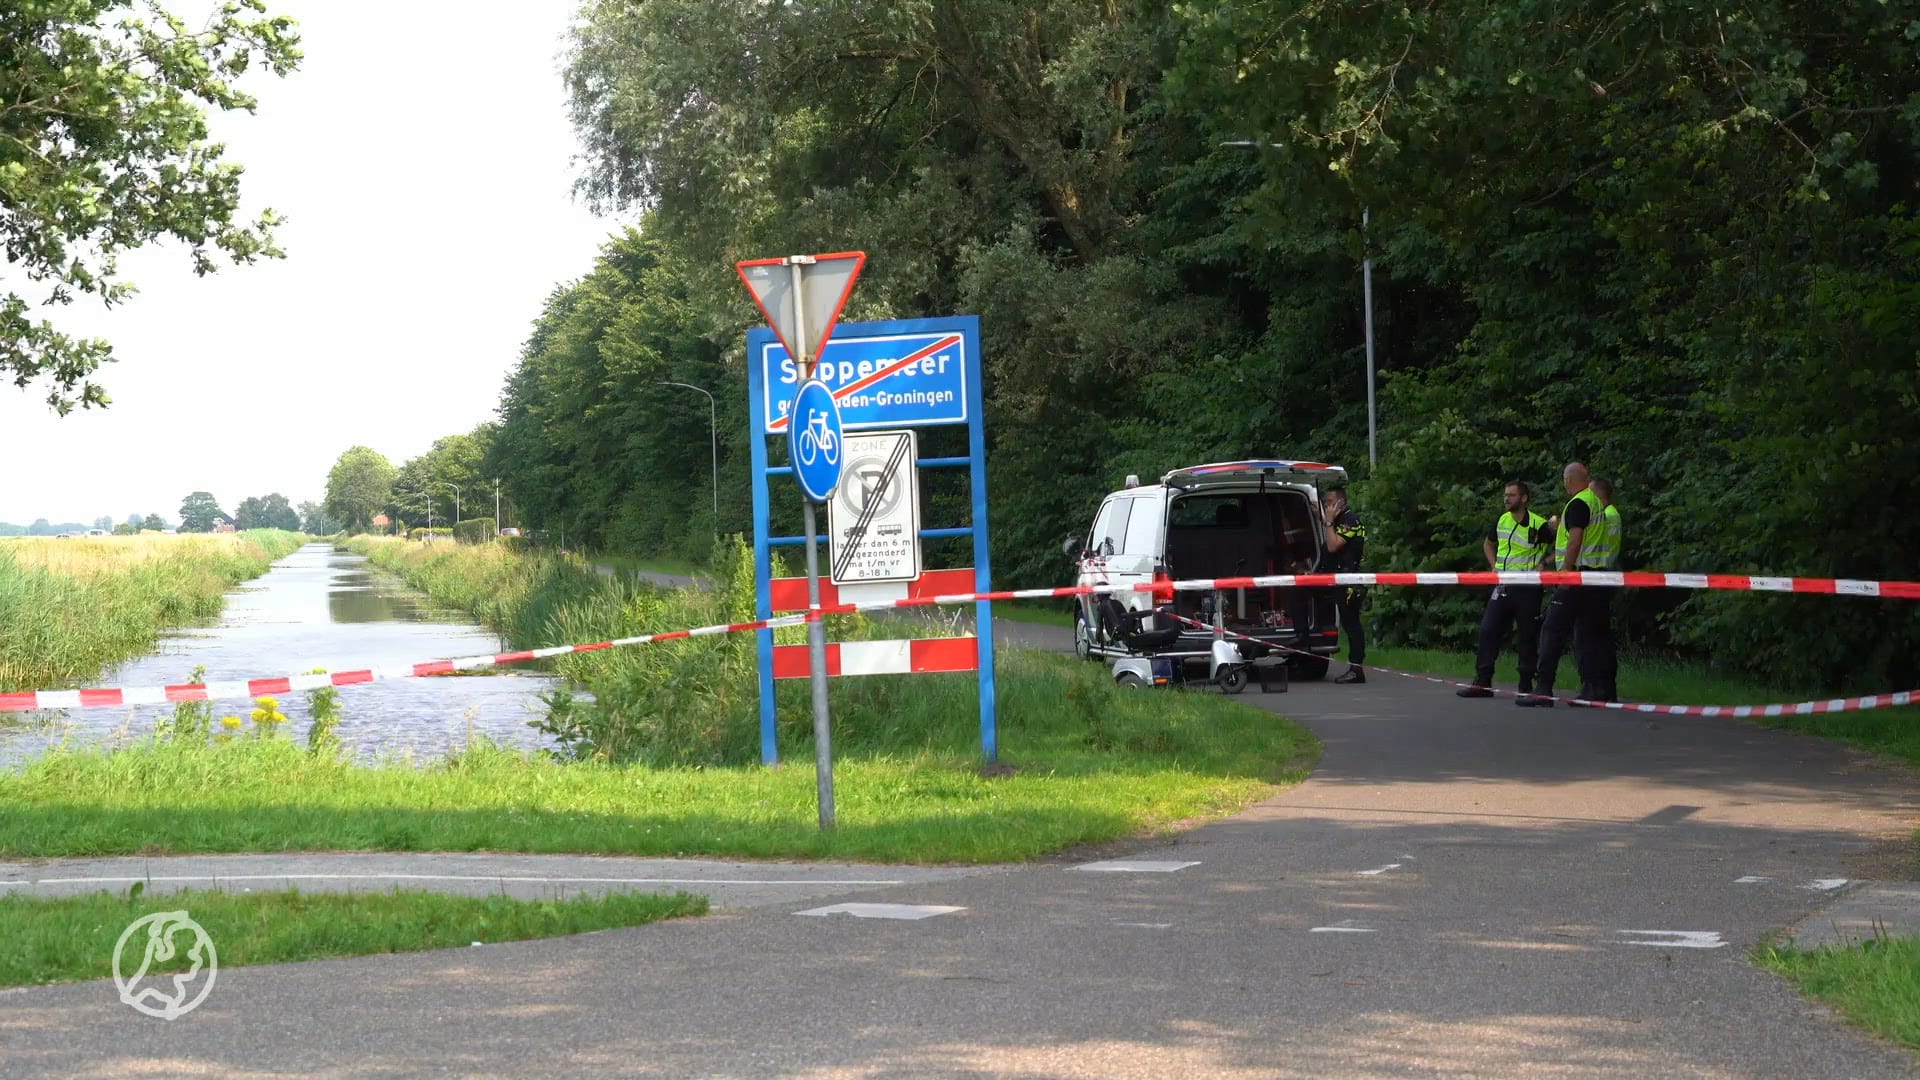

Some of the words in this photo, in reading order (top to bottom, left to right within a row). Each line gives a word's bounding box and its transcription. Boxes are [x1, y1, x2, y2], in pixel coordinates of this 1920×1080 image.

[780, 354, 950, 385] Sppemeer
[851, 440, 887, 452] ZONE
[867, 559, 886, 568] t/m
[859, 569, 880, 577] 8-18
